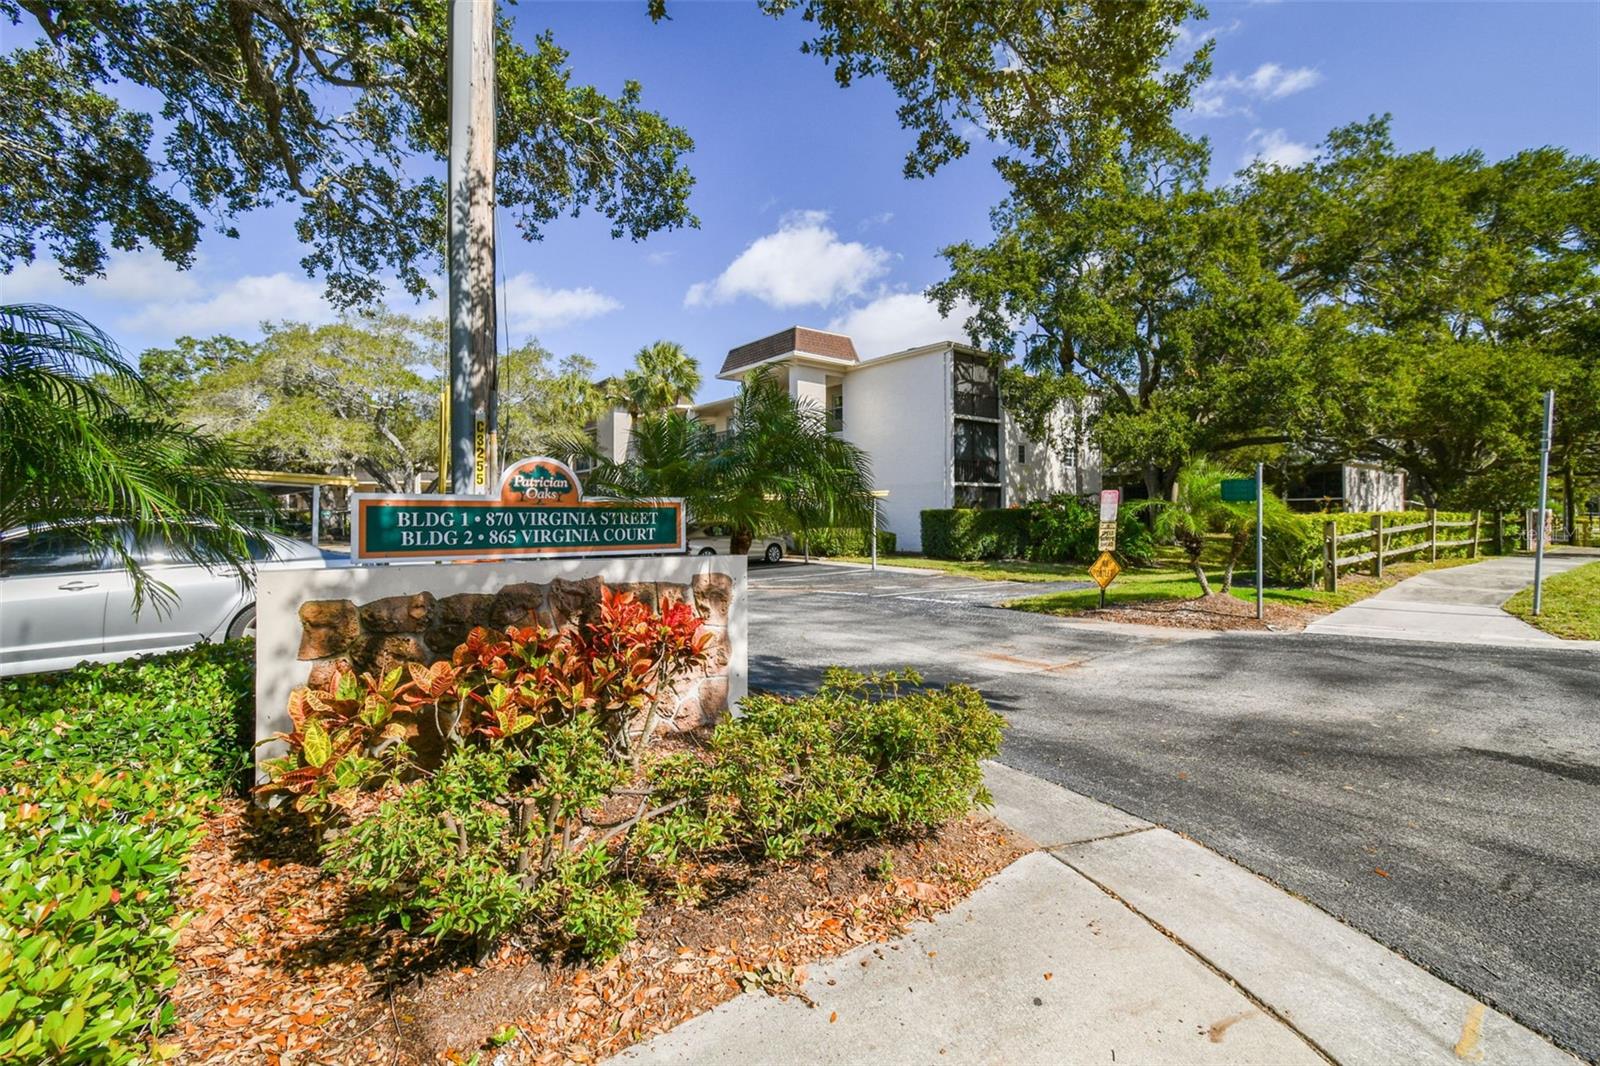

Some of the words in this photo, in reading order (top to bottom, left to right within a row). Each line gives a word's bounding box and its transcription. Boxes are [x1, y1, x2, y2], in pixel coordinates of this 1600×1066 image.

[476, 420, 484, 485] C3255
[513, 475, 569, 488] Patrician
[526, 488, 557, 500] Oaks
[397, 511, 455, 528] BLDG
[460, 512, 469, 527] 1
[485, 511, 513, 527] 870
[517, 511, 598, 527] VIRGINIA
[600, 511, 659, 526] STREET
[401, 530, 458, 546] BLDG
[463, 530, 473, 545] 2
[489, 529, 517, 544] 865
[521, 528, 600, 544] VIRGINIA
[603, 527, 657, 542] COURT
